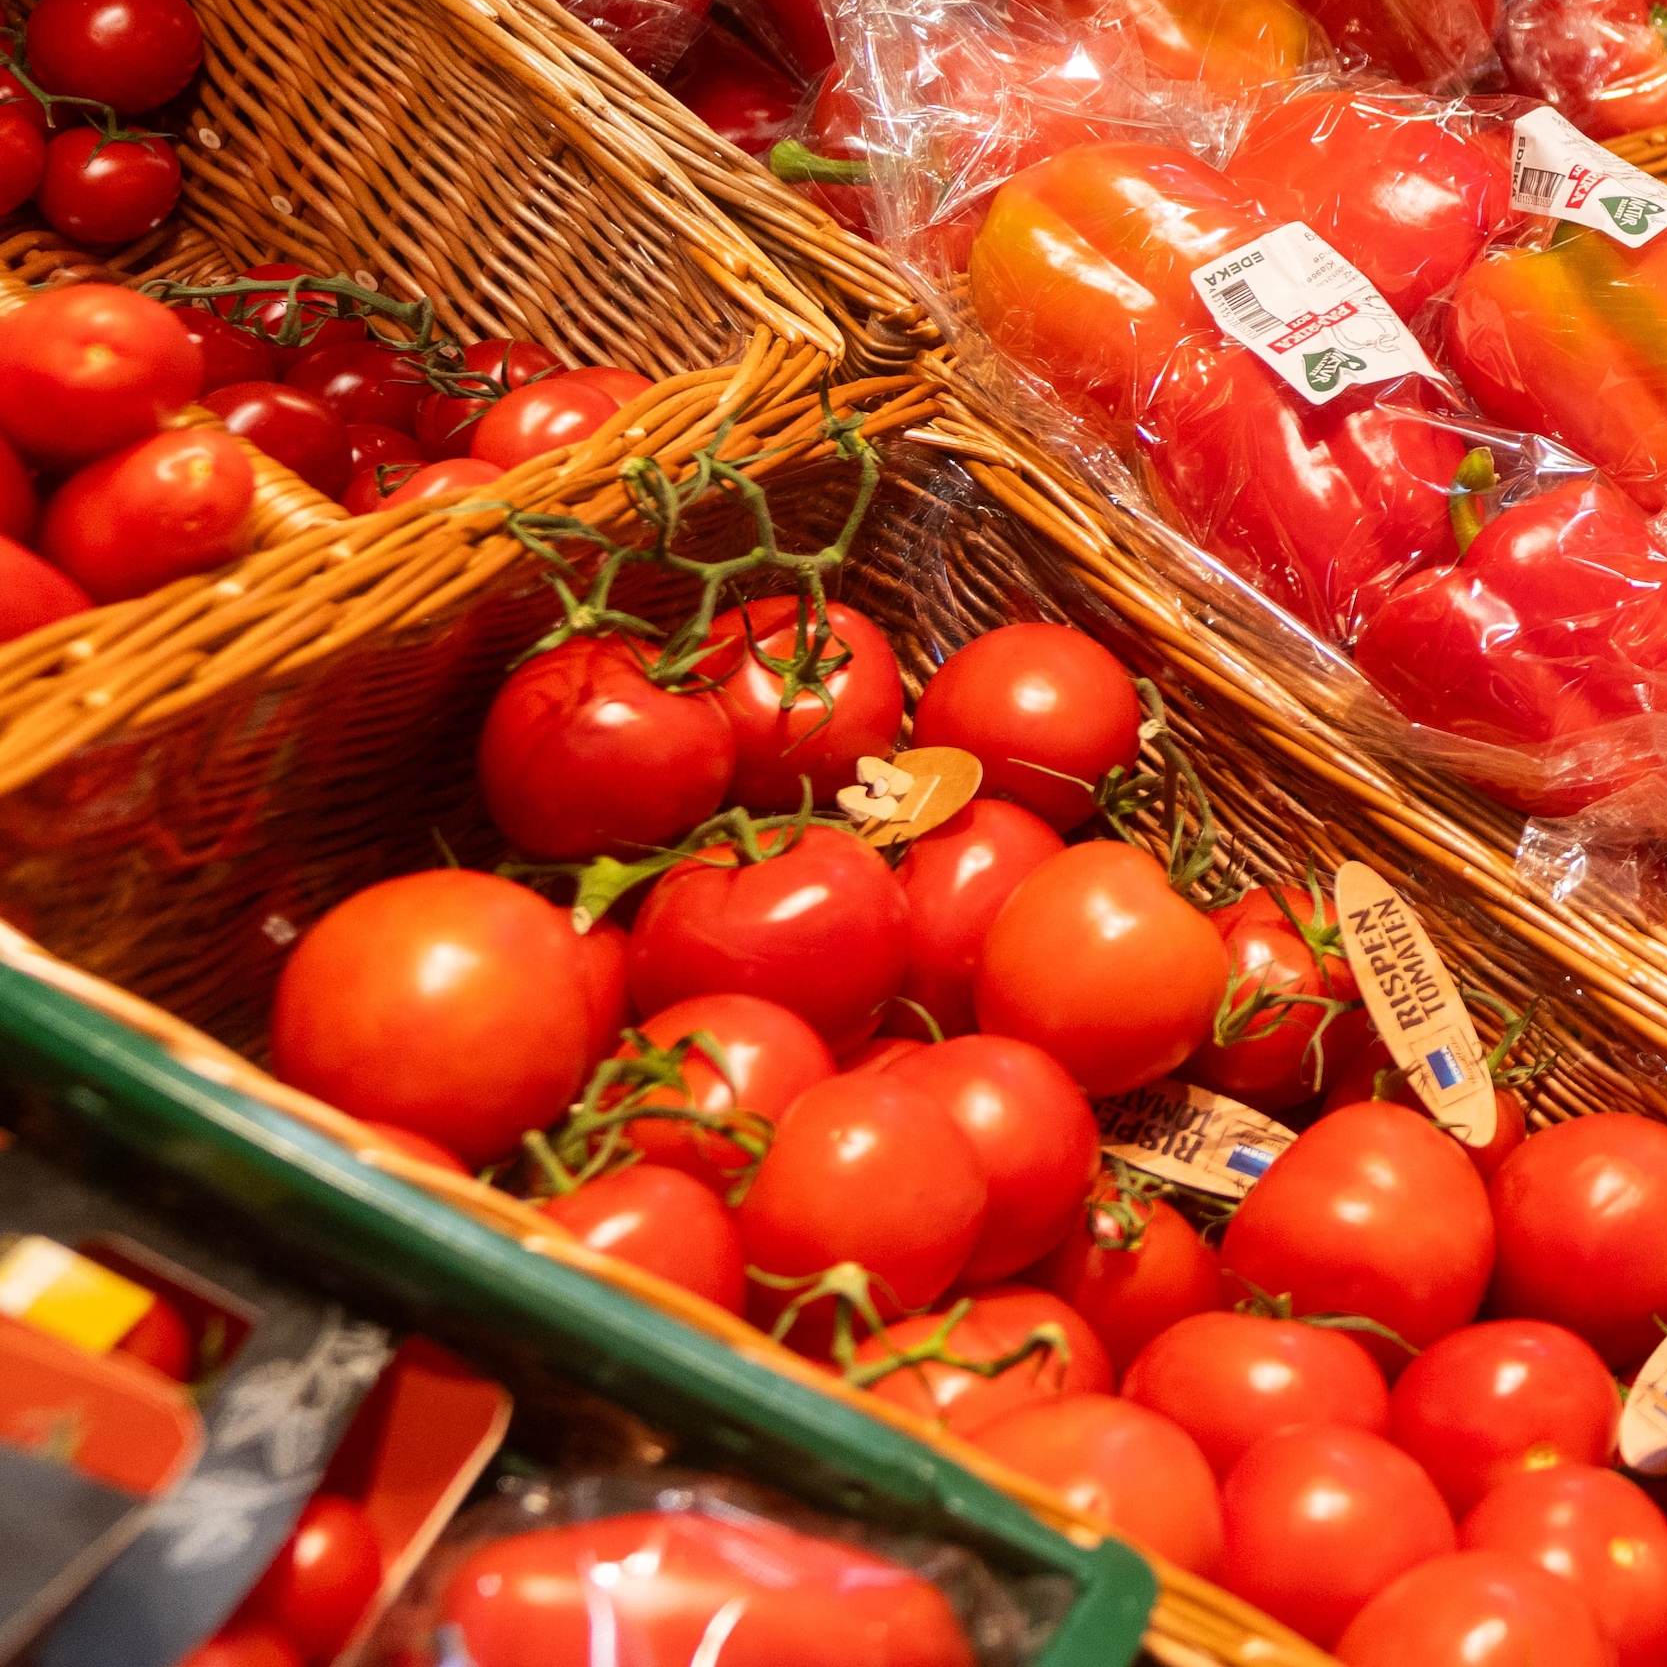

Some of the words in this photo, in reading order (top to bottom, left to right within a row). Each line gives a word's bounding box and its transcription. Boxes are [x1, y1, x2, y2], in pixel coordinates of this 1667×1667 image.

[1510, 135, 1527, 201] EDEKA
[1620, 196, 1650, 228] NATUR
[1203, 250, 1265, 288] EDEKA
[1306, 259, 1337, 286] Klasse
[1272, 300, 1353, 351] PAPRIKA
[1289, 312, 1315, 330] ROT
[1347, 907, 1425, 1032] RISPEN
[1373, 895, 1447, 1022] TOMATEN
[1440, 1045, 1467, 1084] EDEKA
[1094, 1106, 1206, 1164] RISPE
[1114, 1086, 1215, 1138] TOMAT
